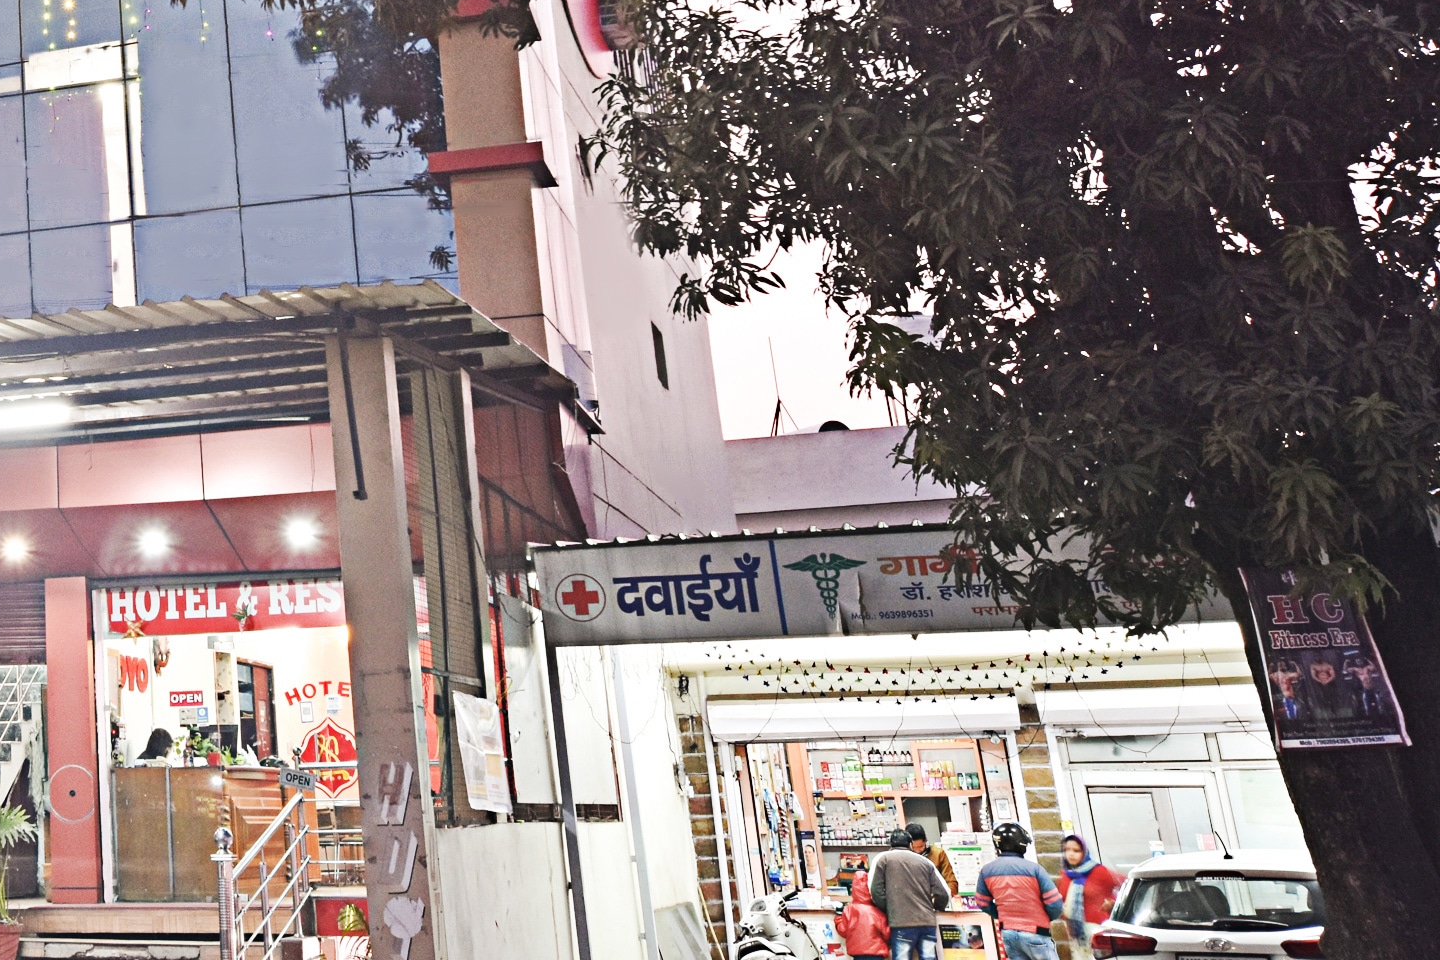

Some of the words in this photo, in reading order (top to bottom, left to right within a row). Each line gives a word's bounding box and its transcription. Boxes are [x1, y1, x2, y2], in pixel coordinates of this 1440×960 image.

[612, 552, 761, 622] दवाईयाँ
[111, 584, 228, 623] HOTEL
[235, 581, 258, 617] &
[879, 609, 935, 620] 9639896351
[1268, 629, 1330, 649] Fitness
[1327, 627, 1360, 646] Era
[170, 693, 203, 704] OPEN
[285, 772, 311, 787] OPEN
